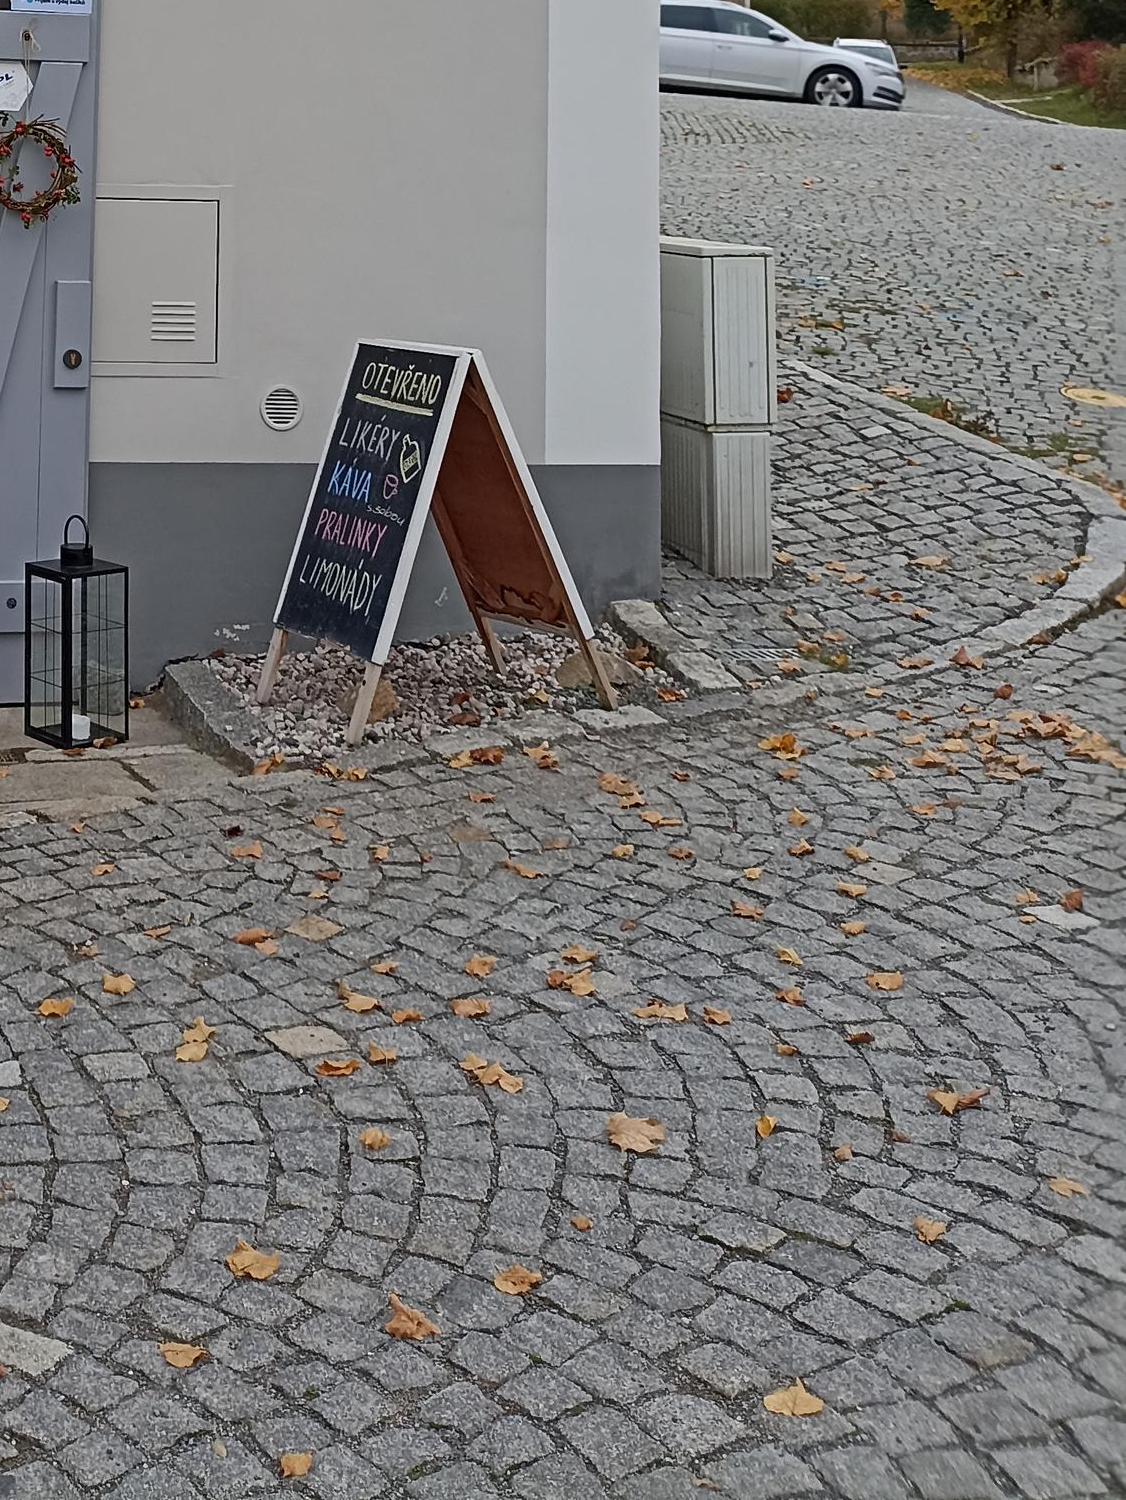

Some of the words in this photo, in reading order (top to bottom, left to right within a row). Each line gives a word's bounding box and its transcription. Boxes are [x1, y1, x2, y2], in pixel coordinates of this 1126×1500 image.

[362, 362, 442, 405] OTEVŘENO
[339, 414, 401, 462] LIKÉRY
[327, 458, 372, 503] KÁVA
[314, 508, 388, 558] PRALINKY
[299, 554, 382, 617] LIMONÁDY
